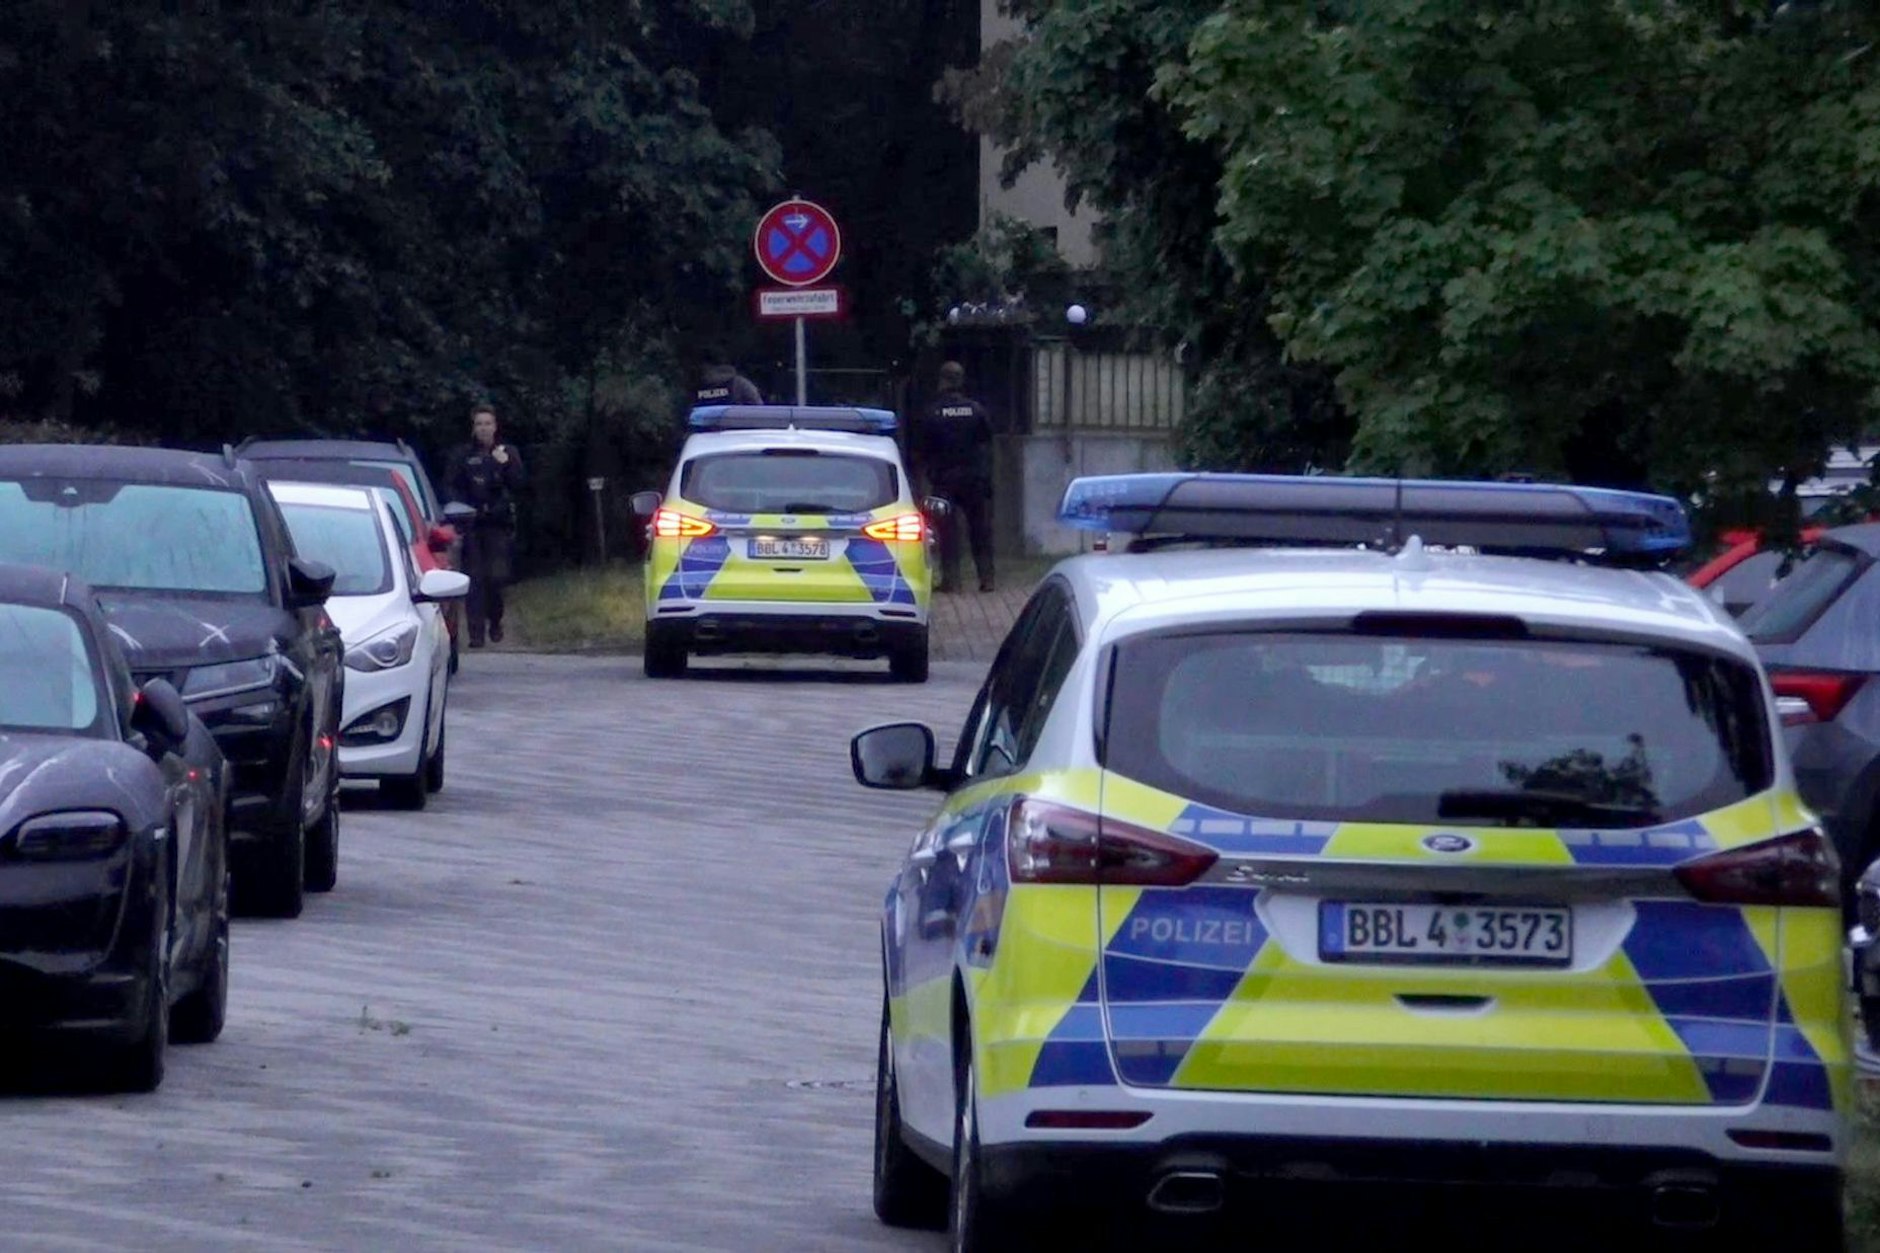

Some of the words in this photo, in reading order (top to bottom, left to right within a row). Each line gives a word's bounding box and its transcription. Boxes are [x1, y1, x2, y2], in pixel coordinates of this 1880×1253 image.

[697, 388, 729, 399] POLIZEI
[942, 407, 973, 417] POLIZEI
[757, 542, 779, 555] BBL
[1130, 917, 1252, 944] POLIZEI
[1350, 908, 1417, 947] BBL
[1427, 911, 1447, 947] 4
[1475, 911, 1564, 951] 3573
